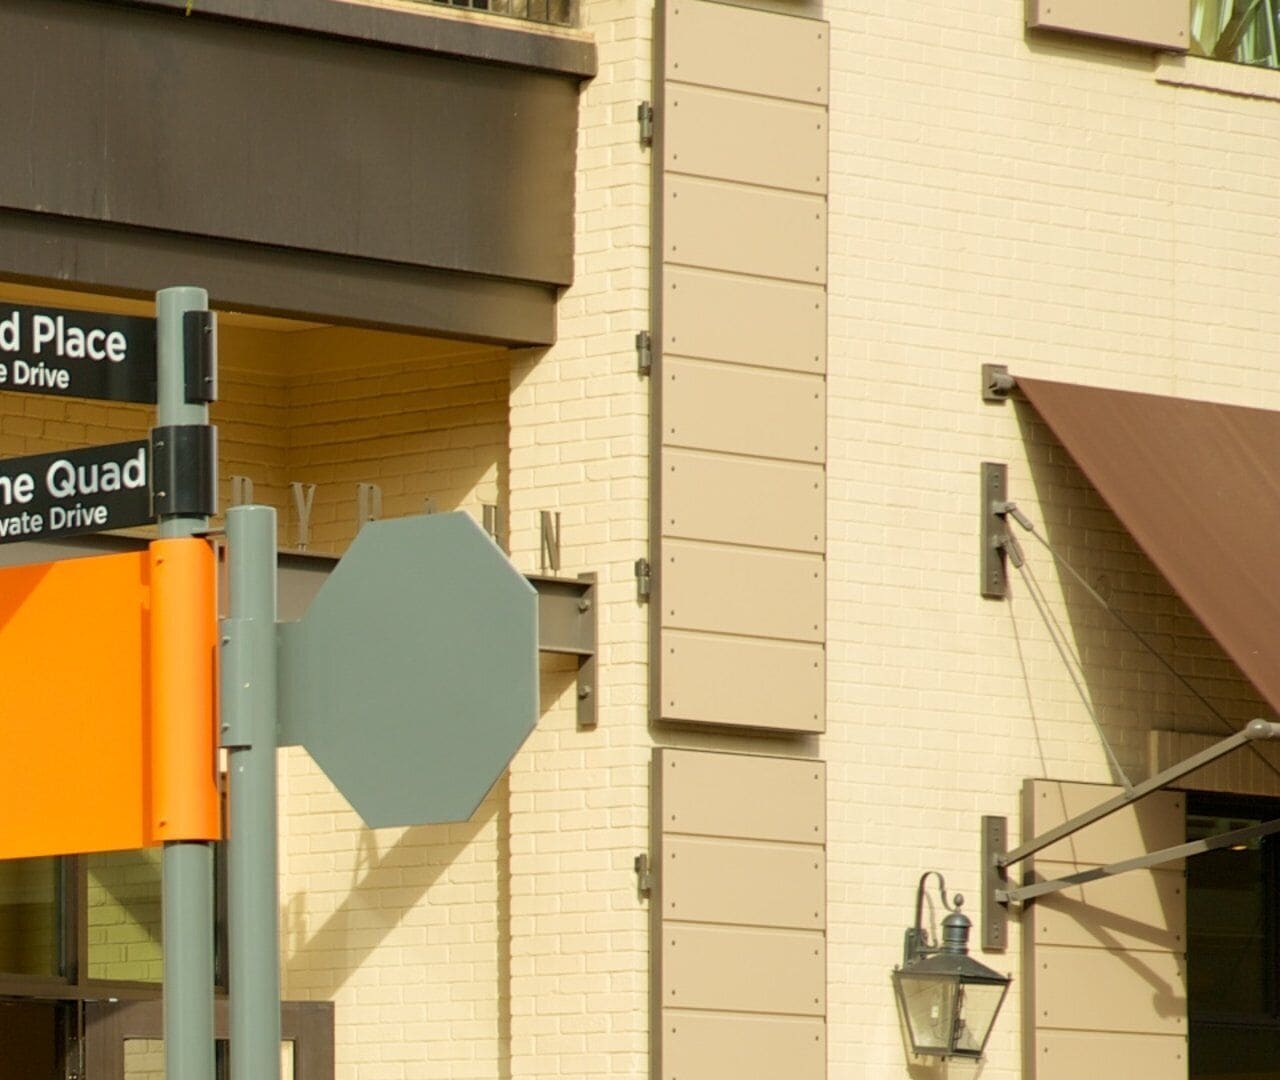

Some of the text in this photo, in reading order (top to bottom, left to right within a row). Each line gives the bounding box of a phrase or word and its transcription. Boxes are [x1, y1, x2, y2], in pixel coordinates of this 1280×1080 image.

[33, 314, 127, 363] Place
[13, 360, 70, 389] Drive
[46, 447, 146, 499] Quad
[49, 503, 108, 531] Drive
